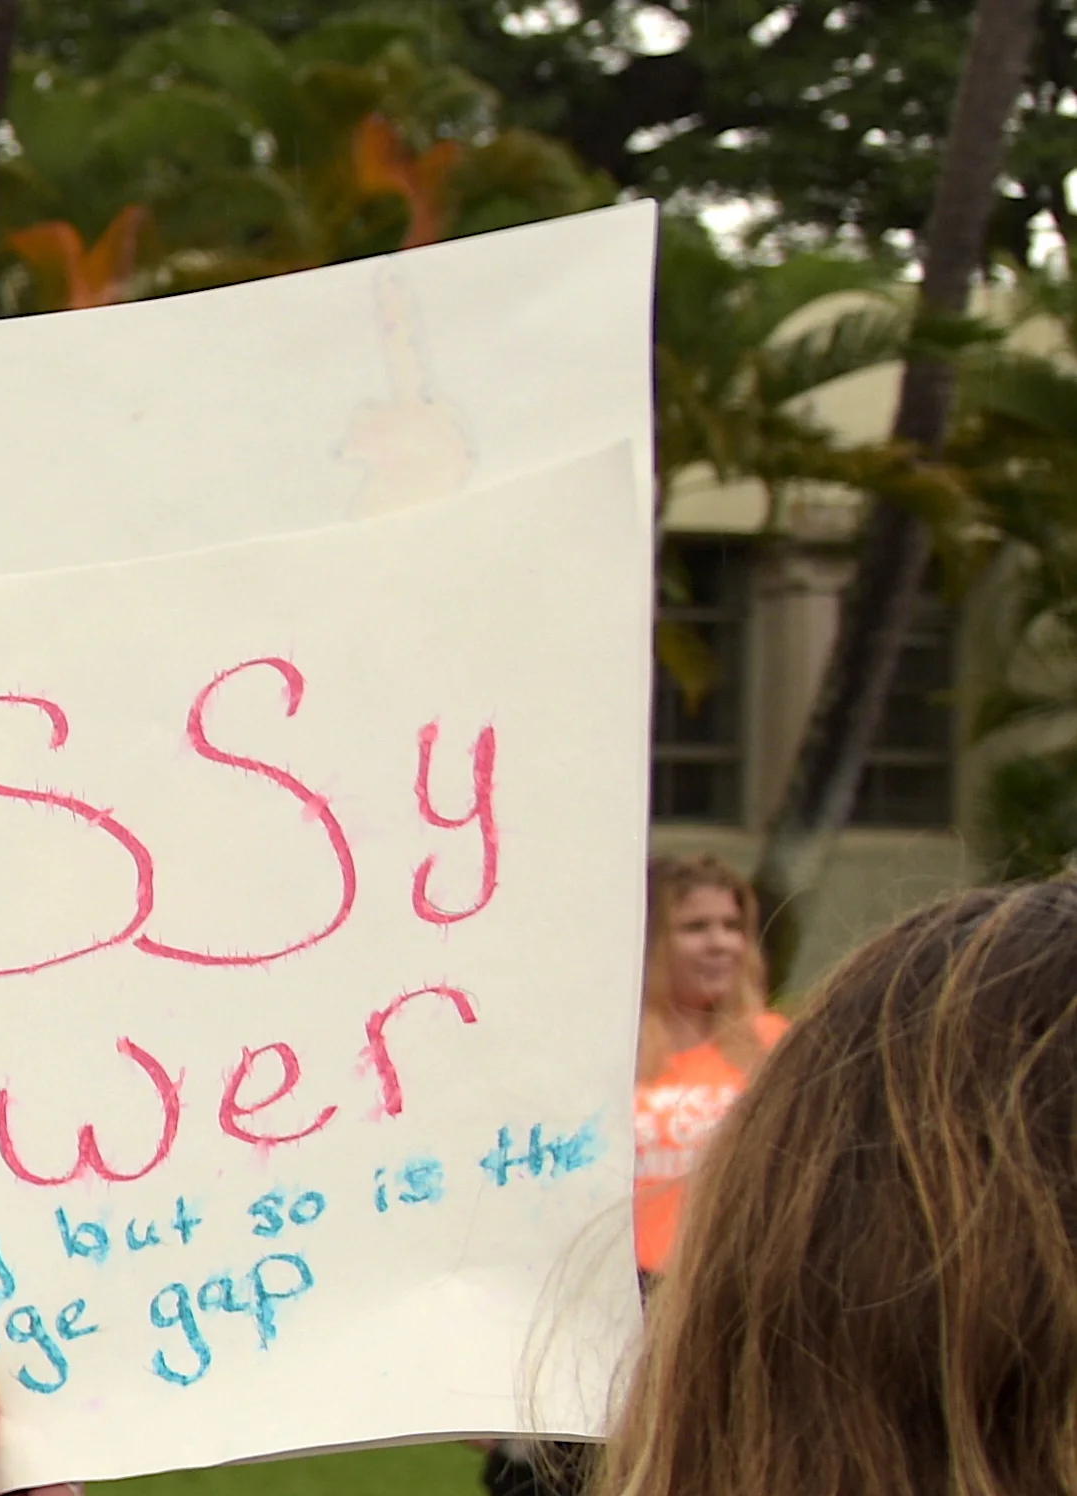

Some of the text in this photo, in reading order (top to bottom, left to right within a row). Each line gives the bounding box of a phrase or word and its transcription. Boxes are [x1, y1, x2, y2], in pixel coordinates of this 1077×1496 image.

[54, 1195, 203, 1262] but
[247, 1190, 326, 1238] so
[374, 1160, 444, 1214] is
[478, 1114, 602, 1188] the
[148, 1252, 316, 1387] gap
